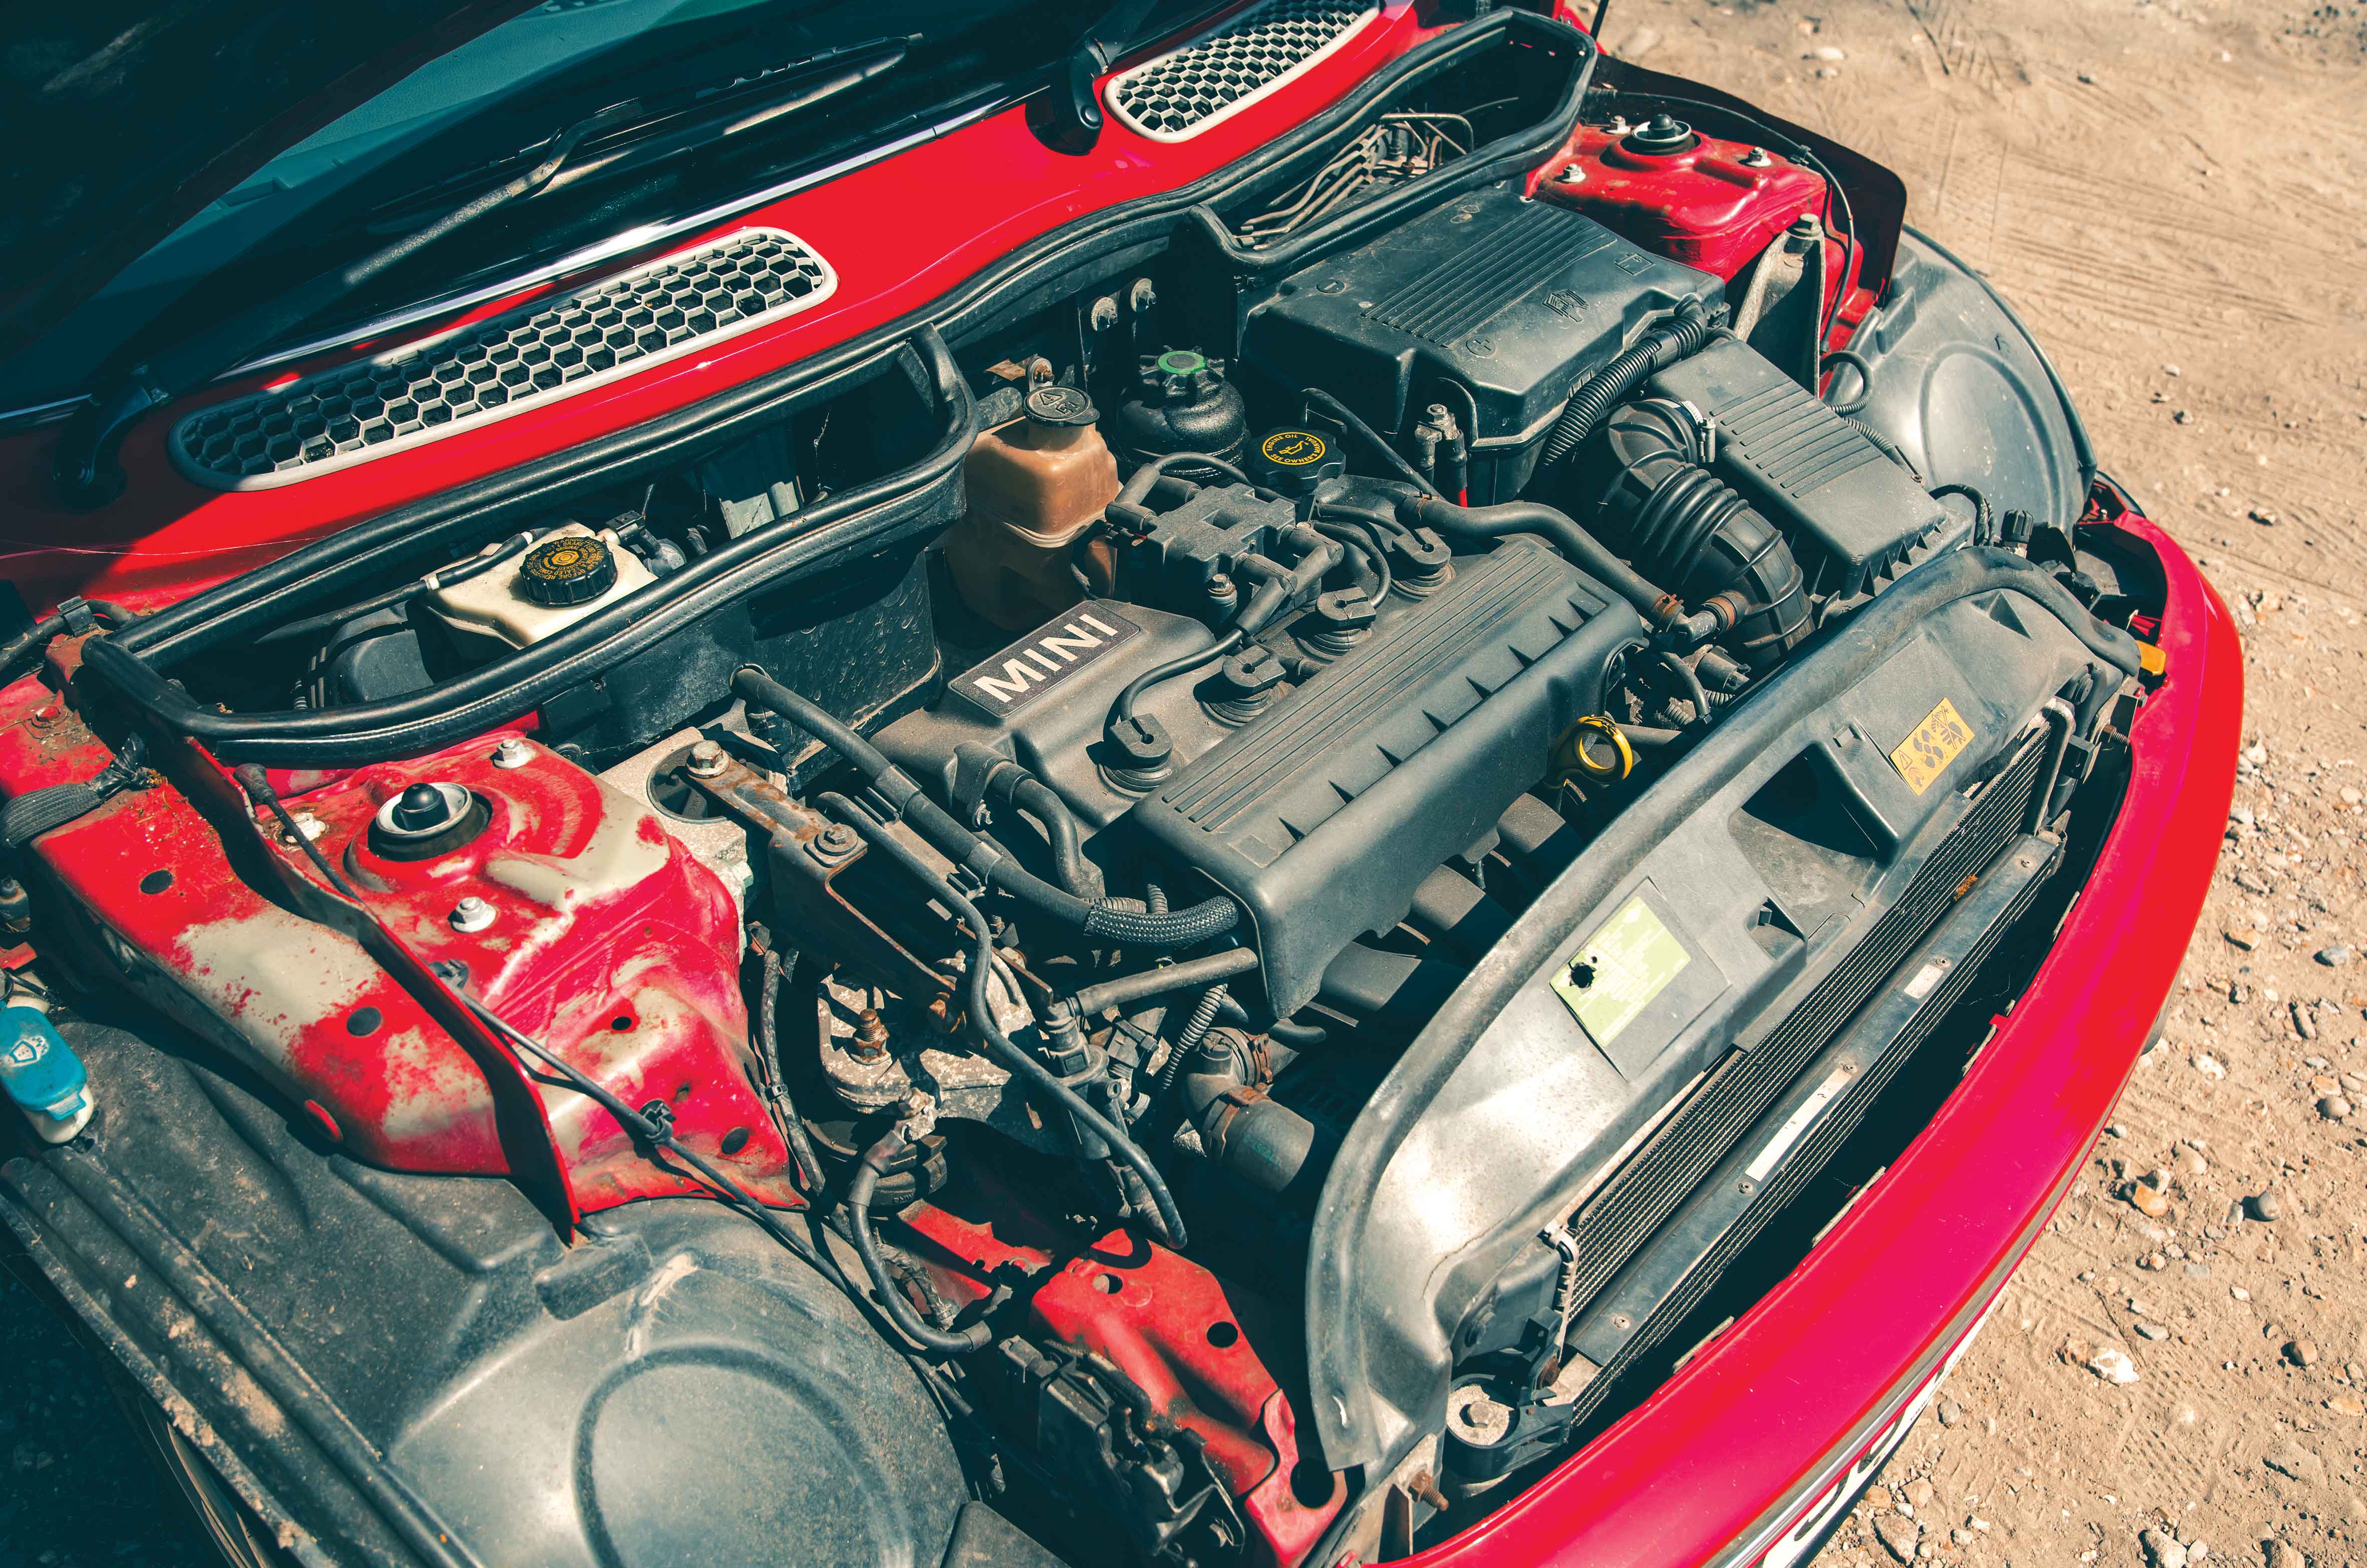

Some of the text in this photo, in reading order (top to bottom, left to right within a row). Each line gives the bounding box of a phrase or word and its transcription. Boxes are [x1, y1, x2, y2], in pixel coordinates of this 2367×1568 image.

[1267, 435, 1284, 451] ENGINE
[1270, 436, 1321, 463] SEE OWNER'S MANUAL
[587, 561, 598, 570] CAP
[973, 613, 1118, 703] MINI
